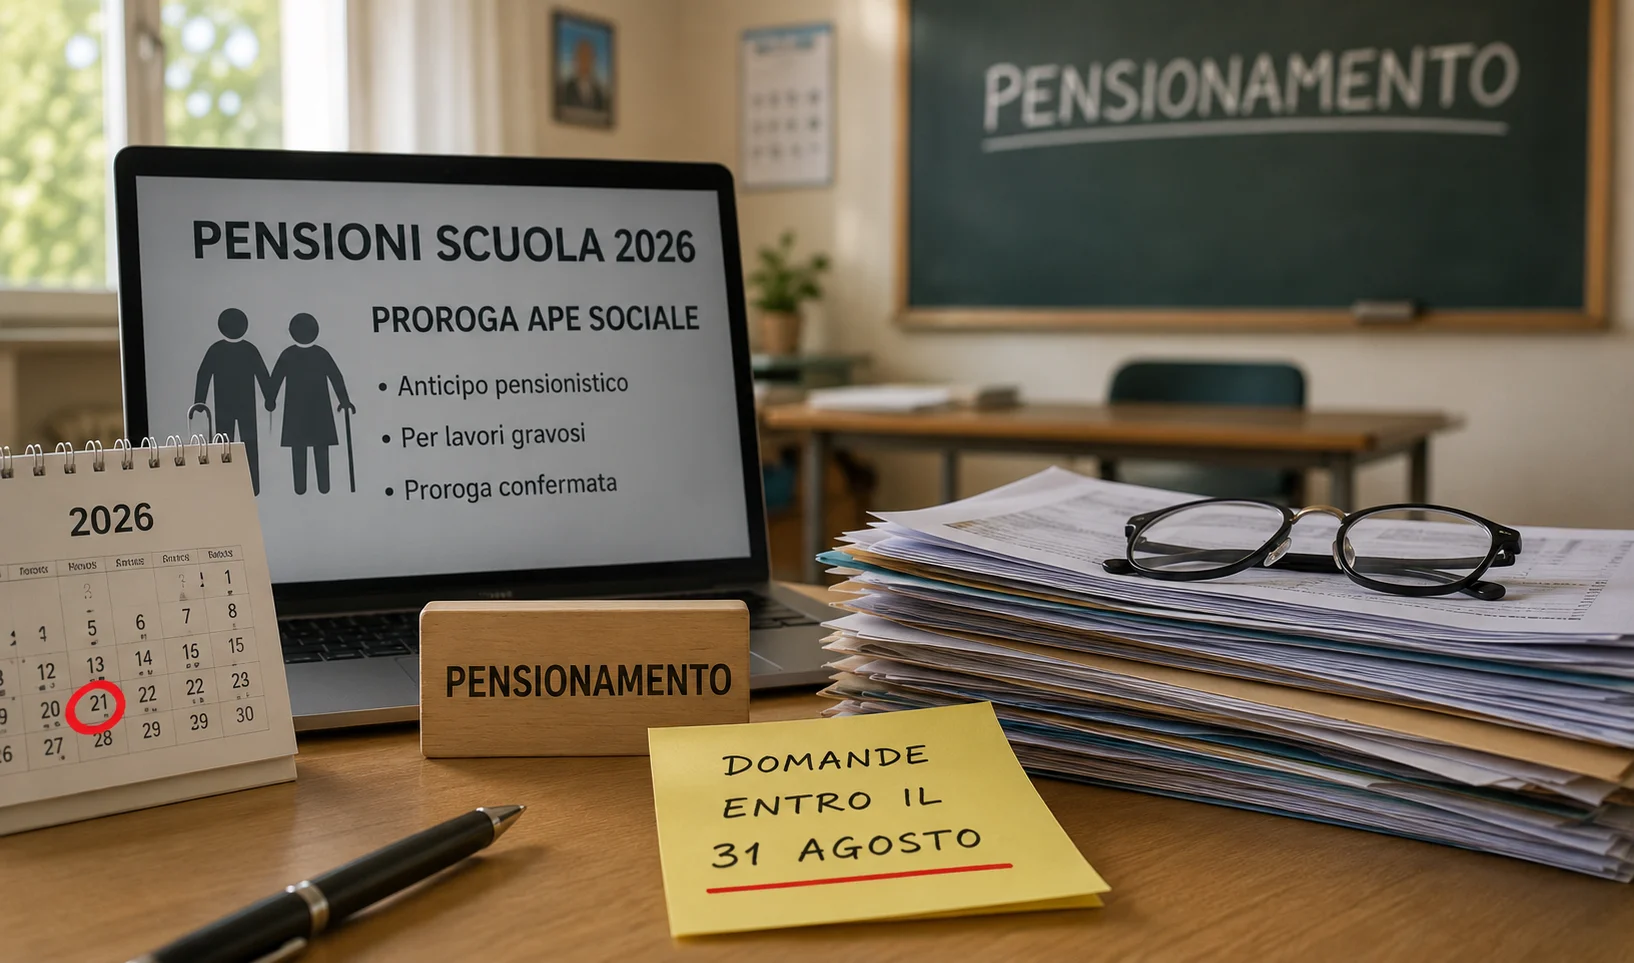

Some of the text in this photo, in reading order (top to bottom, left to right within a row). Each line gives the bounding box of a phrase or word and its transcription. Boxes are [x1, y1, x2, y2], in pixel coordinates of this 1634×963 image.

[984, 42, 1519, 132] PENSIONAMENTO
[193, 220, 696, 264] PENSIONI SCUOLA 2026
[372, 304, 699, 334] PROROGA APE SOCIALE
[398, 373, 629, 401] Anticipo pensionistico
[401, 422, 586, 449] Per lavori gravosi
[404, 473, 617, 503] Proroga confermata
[69, 502, 154, 536] 2026
[88, 620, 97, 636] 5
[136, 614, 146, 630] 6
[182, 608, 191, 624] 7
[228, 603, 238, 618] 8
[37, 637, 245, 680] 12 13 14 15 15
[41, 700, 60, 719] 20
[90, 693, 108, 712] 21
[138, 685, 157, 703] 22
[186, 678, 205, 696] 22
[232, 671, 250, 689] 23
[446, 663, 732, 697] PENSIONAMENTO
[44, 737, 63, 756] 27
[94, 730, 113, 748] 28
[142, 721, 161, 739] 29
[236, 706, 254, 723] 30
[723, 745, 929, 776] DOMANDE
[723, 788, 942, 818] ENTRO IL
[711, 829, 982, 868] 31 AGOSTO
